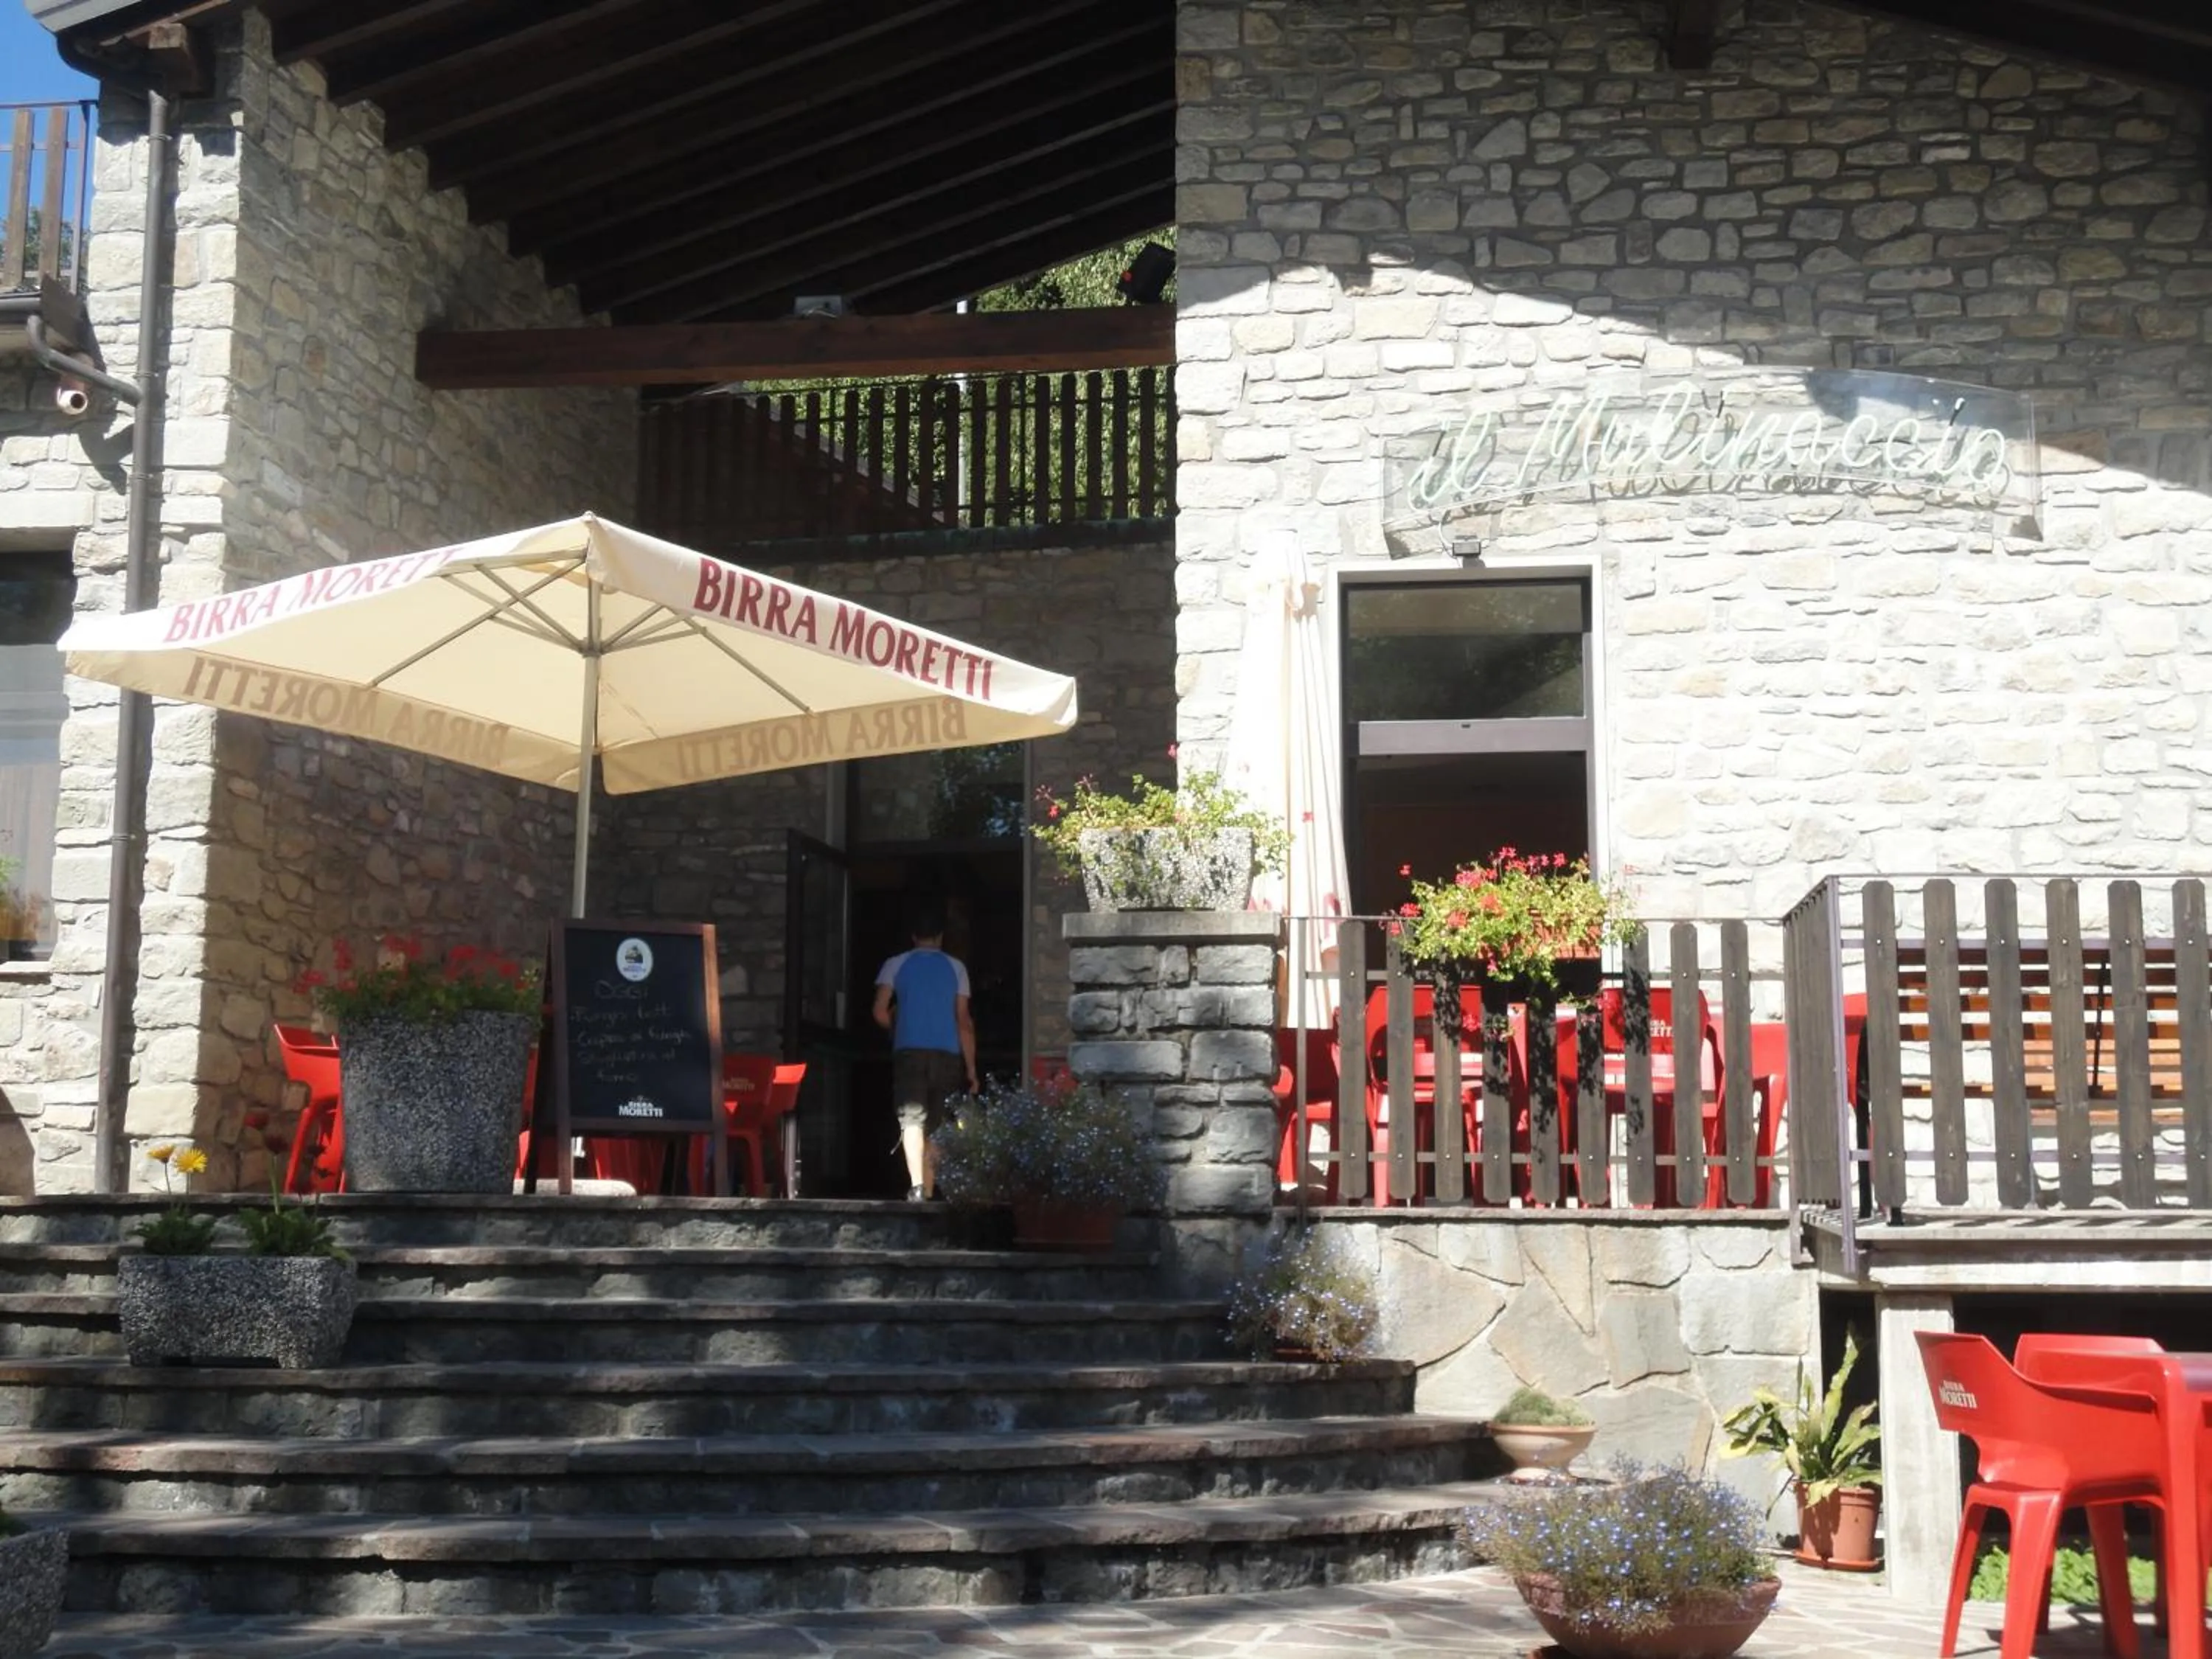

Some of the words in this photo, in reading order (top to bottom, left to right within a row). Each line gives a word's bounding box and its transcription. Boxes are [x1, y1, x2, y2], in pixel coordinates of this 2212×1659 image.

[163, 584, 281, 642] BIRRA
[288, 547, 465, 611] MORETT
[693, 557, 817, 645] BIRRA
[828, 601, 992, 700] MORETTI
[1938, 1385, 1978, 1409] MORETTI
